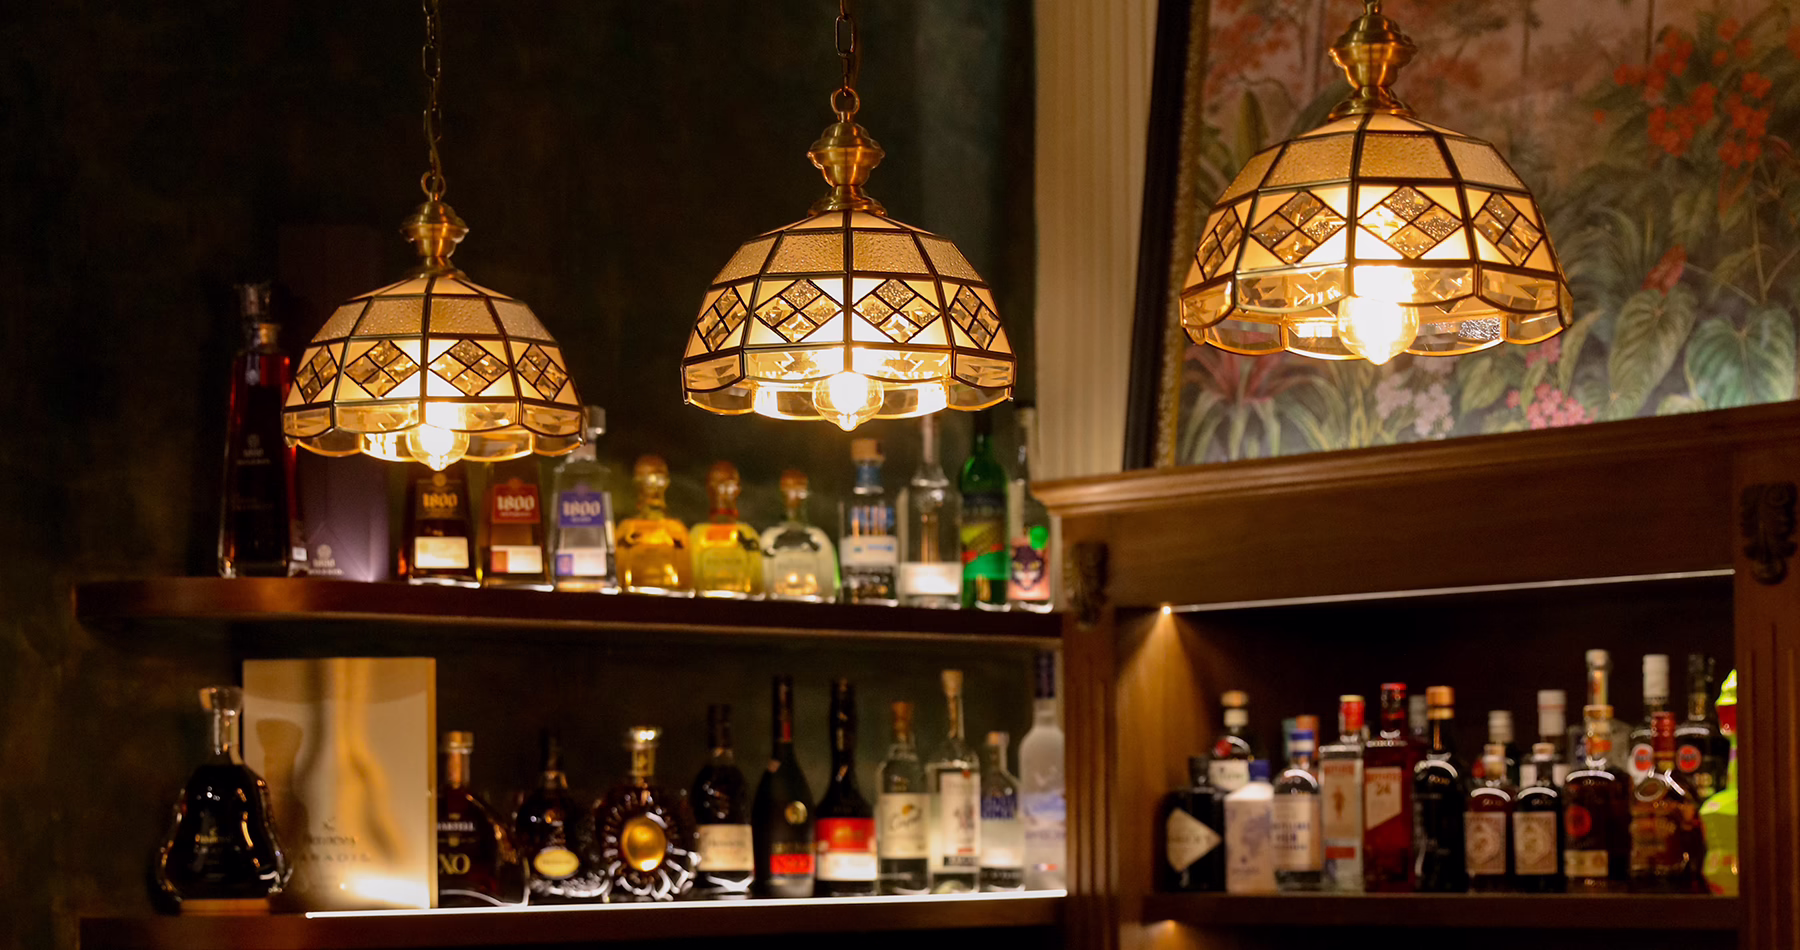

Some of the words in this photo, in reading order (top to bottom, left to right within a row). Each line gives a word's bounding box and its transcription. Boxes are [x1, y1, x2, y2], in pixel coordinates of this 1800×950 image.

[422, 492, 458, 509] 1800
[497, 495, 535, 511] 1800
[563, 501, 600, 517] 1800
[439, 853, 472, 875] XO
